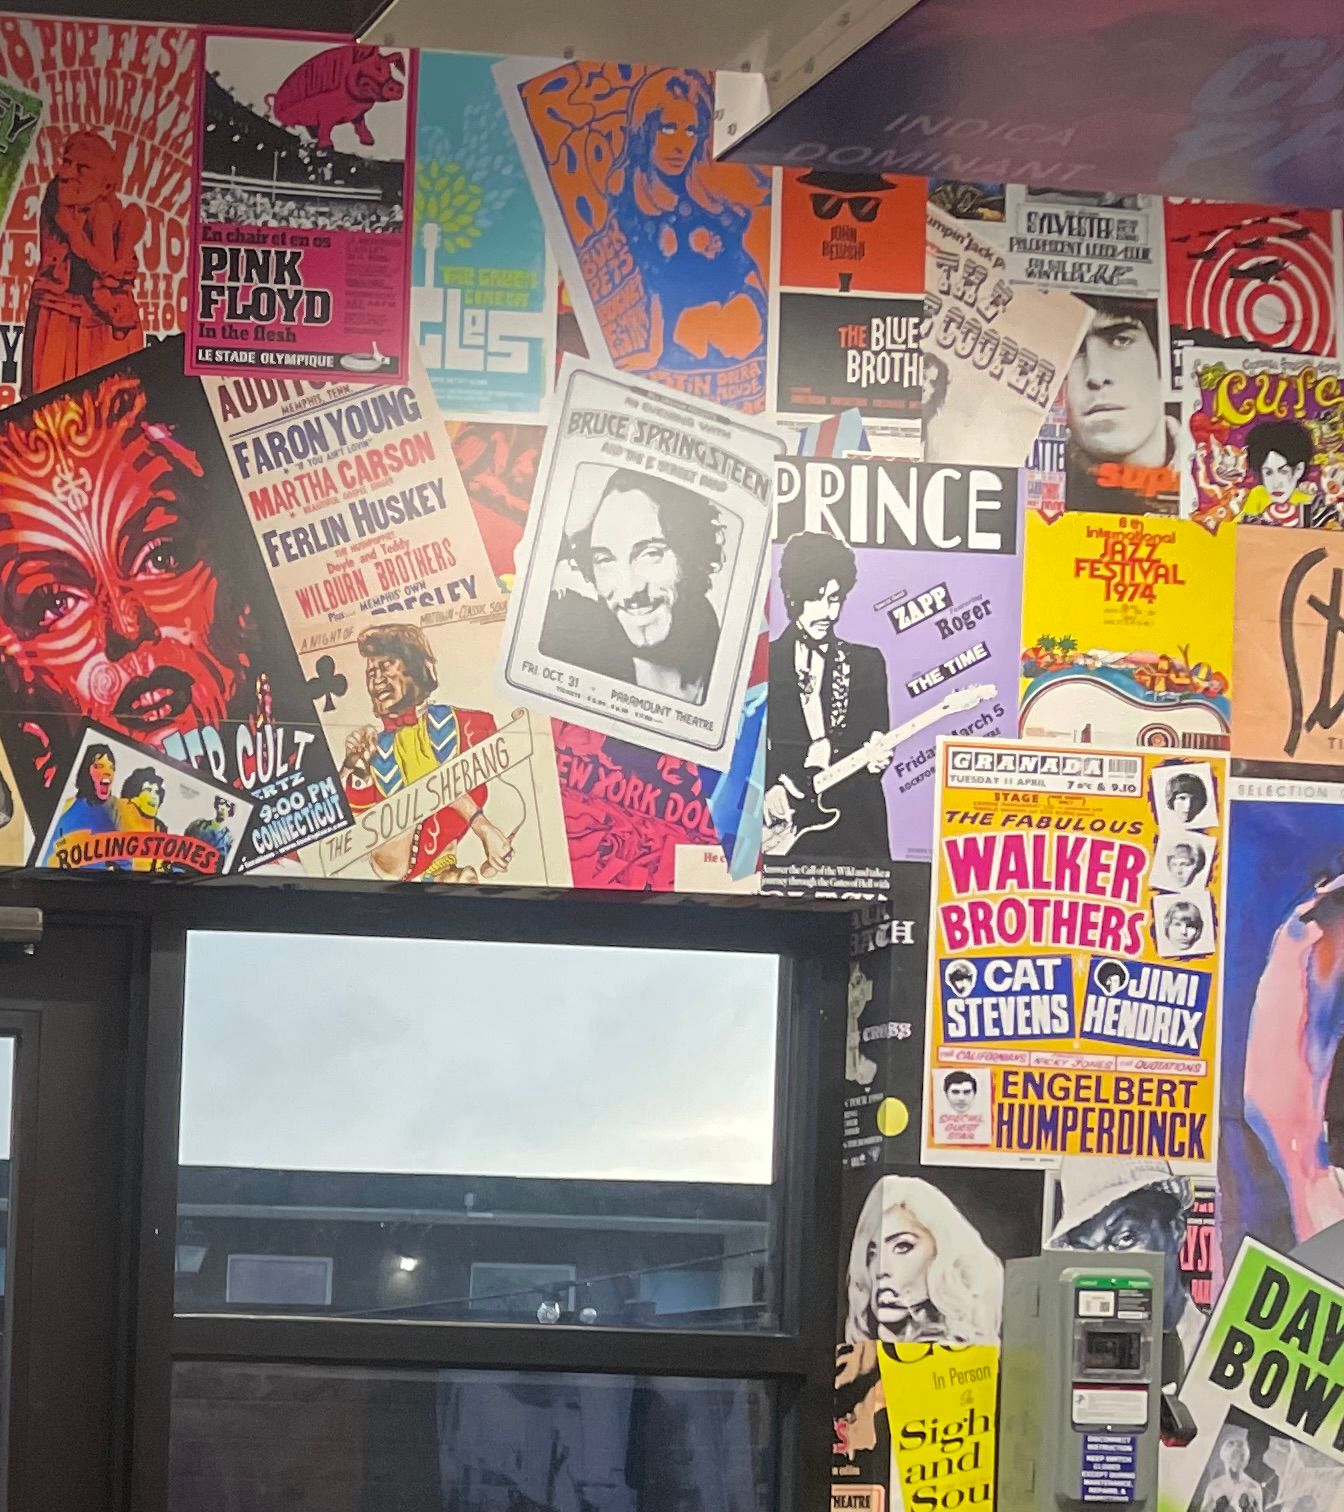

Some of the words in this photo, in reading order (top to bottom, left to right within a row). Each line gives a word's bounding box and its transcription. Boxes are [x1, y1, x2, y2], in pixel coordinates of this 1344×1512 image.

[885, 113, 1077, 148] INDICA
[784, 142, 1097, 184] DOMINANT
[200, 246, 304, 287] PINK
[198, 284, 332, 326] FLOYD
[198, 349, 212, 362] LE
[215, 349, 255, 364] STADE
[260, 352, 335, 368] OLYMPIQUE
[234, 417, 324, 479] FARON
[327, 387, 421, 440] YOUNG
[569, 411, 628, 440] BRUCE
[632, 417, 769, 498] SPRINGSTEEN
[248, 467, 337, 521] MARTHA
[339, 431, 436, 485] CARSON
[264, 514, 347, 568] FERLIN
[351, 479, 447, 541] HUSKEY
[774, 463, 1003, 549] PRINCE
[1075, 560, 1186, 585] FESTIVAL
[1100, 542, 1161, 561] JAZZ
[295, 570, 365, 619] WILBURN
[378, 538, 457, 588] BROTHERS
[1104, 583, 1155, 601] 1974
[892, 587, 950, 633] ZAPP
[934, 599, 992, 640] Roger
[909, 664, 944, 696] THE
[945, 642, 990, 678] TIME
[612, 690, 672, 720] PARAMOUNT
[675, 708, 715, 732] THEATRE
[235, 725, 314, 790] CULT
[951, 751, 1104, 777] GRANADA
[251, 794, 346, 850] CONNECTICUT
[259, 792, 307, 822] 9:00
[310, 777, 337, 803] PM
[325, 833, 353, 860] THE
[365, 798, 423, 849] SOUL
[425, 737, 511, 812] SHEBANG
[945, 811, 993, 826] THE
[1001, 813, 1144, 834] FABULOUS
[945, 835, 1148, 902] WALKER
[940, 898, 1145, 954] BROTHERS
[983, 958, 1062, 992] CAT
[1128, 968, 1200, 1007] JIMI
[946, 995, 1070, 1040] STEVENS
[1082, 1001, 1203, 1050] HENDRIX
[1002, 1071, 1198, 1108] ENGELBERT
[995, 1102, 1205, 1158] HUMPERDINCK
